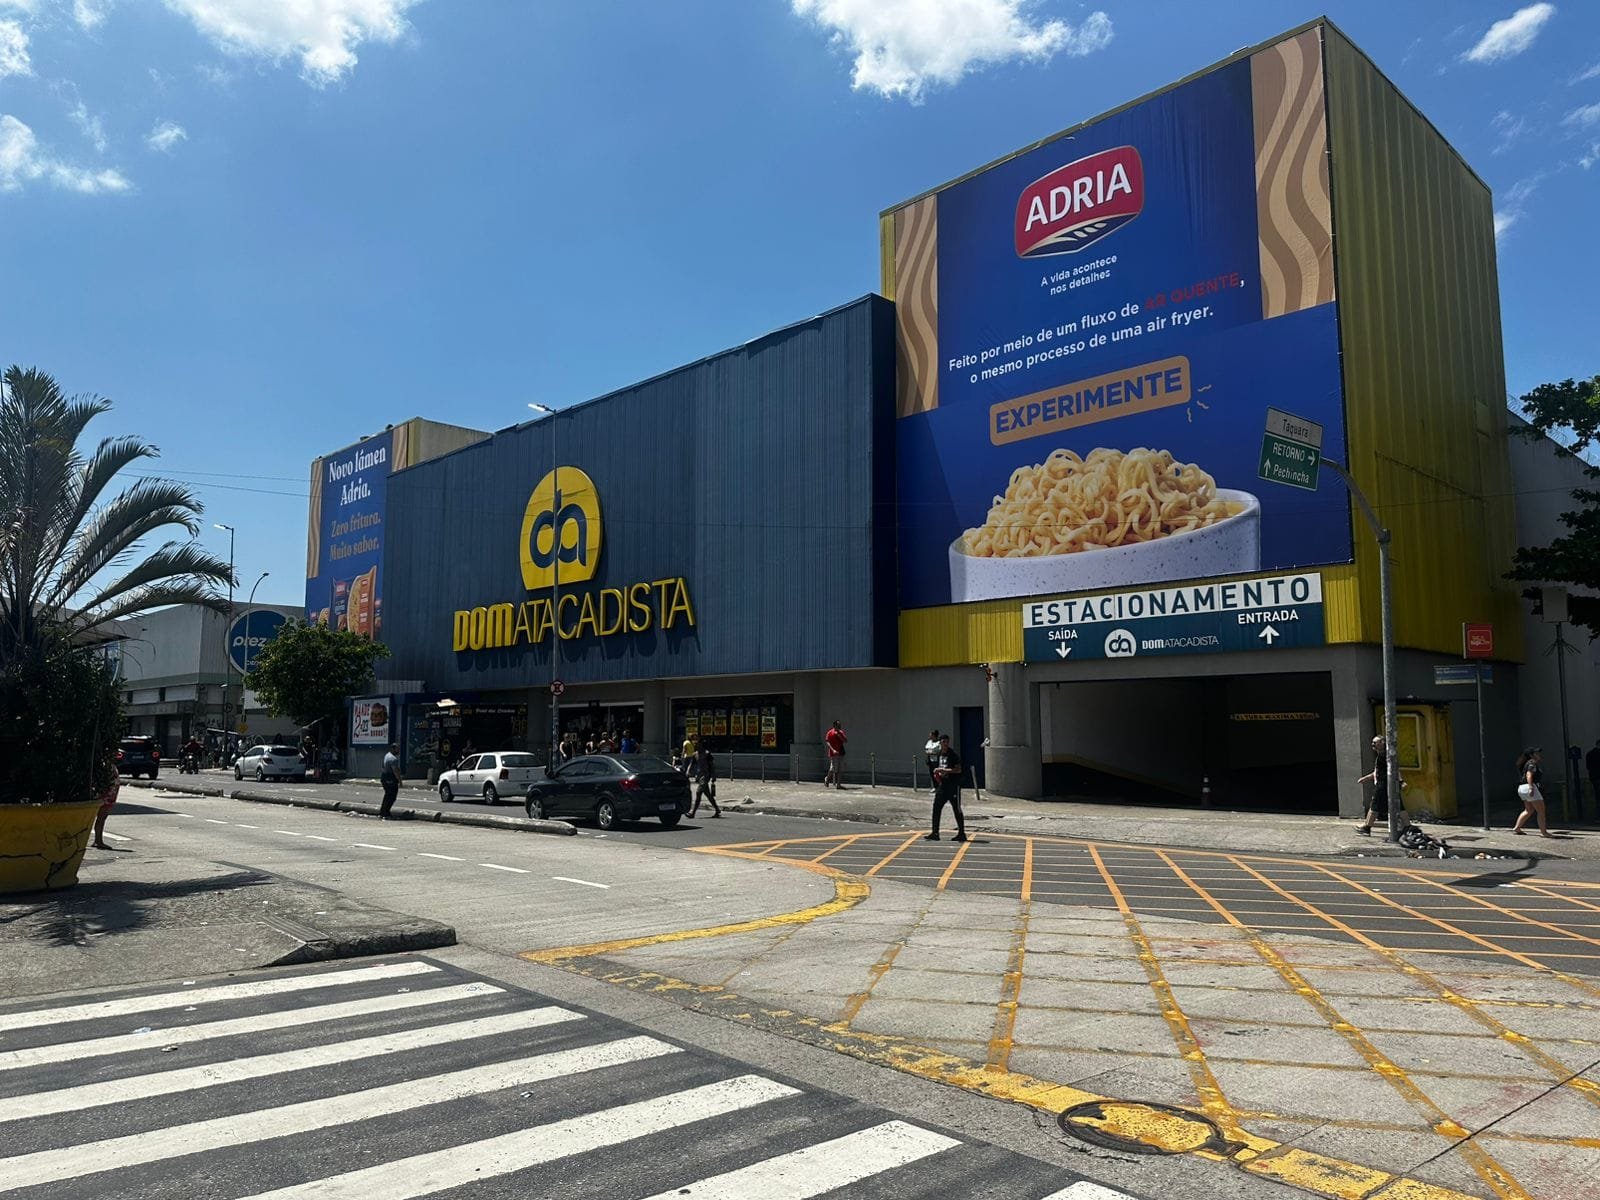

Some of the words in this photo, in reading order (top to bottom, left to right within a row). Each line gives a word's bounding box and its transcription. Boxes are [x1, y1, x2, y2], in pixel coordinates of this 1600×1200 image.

[1024, 162, 1133, 232] ADRIA
[1040, 276, 1048, 287] A
[1050, 268, 1071, 284] vida
[1072, 254, 1118, 276] acontece
[1050, 284, 1067, 296] nos
[1069, 269, 1111, 290] detalhes
[949, 354, 978, 371] Feito
[981, 346, 1001, 363] por
[1003, 334, 1033, 353] meio
[1037, 328, 1053, 343] de
[1056, 321, 1077, 337] um
[1081, 309, 1117, 329] fluxo
[1121, 302, 1140, 318] de
[970, 372, 978, 384] o
[981, 358, 1023, 380] mesmo
[1026, 340, 1085, 369] processo
[1089, 333, 1107, 349] de
[1111, 324, 1142, 342] uma
[1147, 315, 1167, 333] air
[1171, 305, 1214, 327] fryer.
[994, 366, 1183, 435] EXPERIMENTE
[1282, 418, 1310, 438] Taquara
[328, 461, 354, 484] Novo
[355, 446, 387, 474] lámen
[1272, 441, 1305, 462] RETORNO
[1272, 463, 1310, 484] Pechincha
[340, 477, 372, 507] Adria.
[330, 518, 350, 539] Zero
[349, 510, 382, 532] fritura.
[329, 539, 352, 562] Muito
[352, 534, 380, 556] sabor.
[1030, 577, 1310, 626] ESTACIONAMENTO
[1047, 627, 1078, 640] SAÍDA
[1237, 609, 1299, 625] ENTRADA
